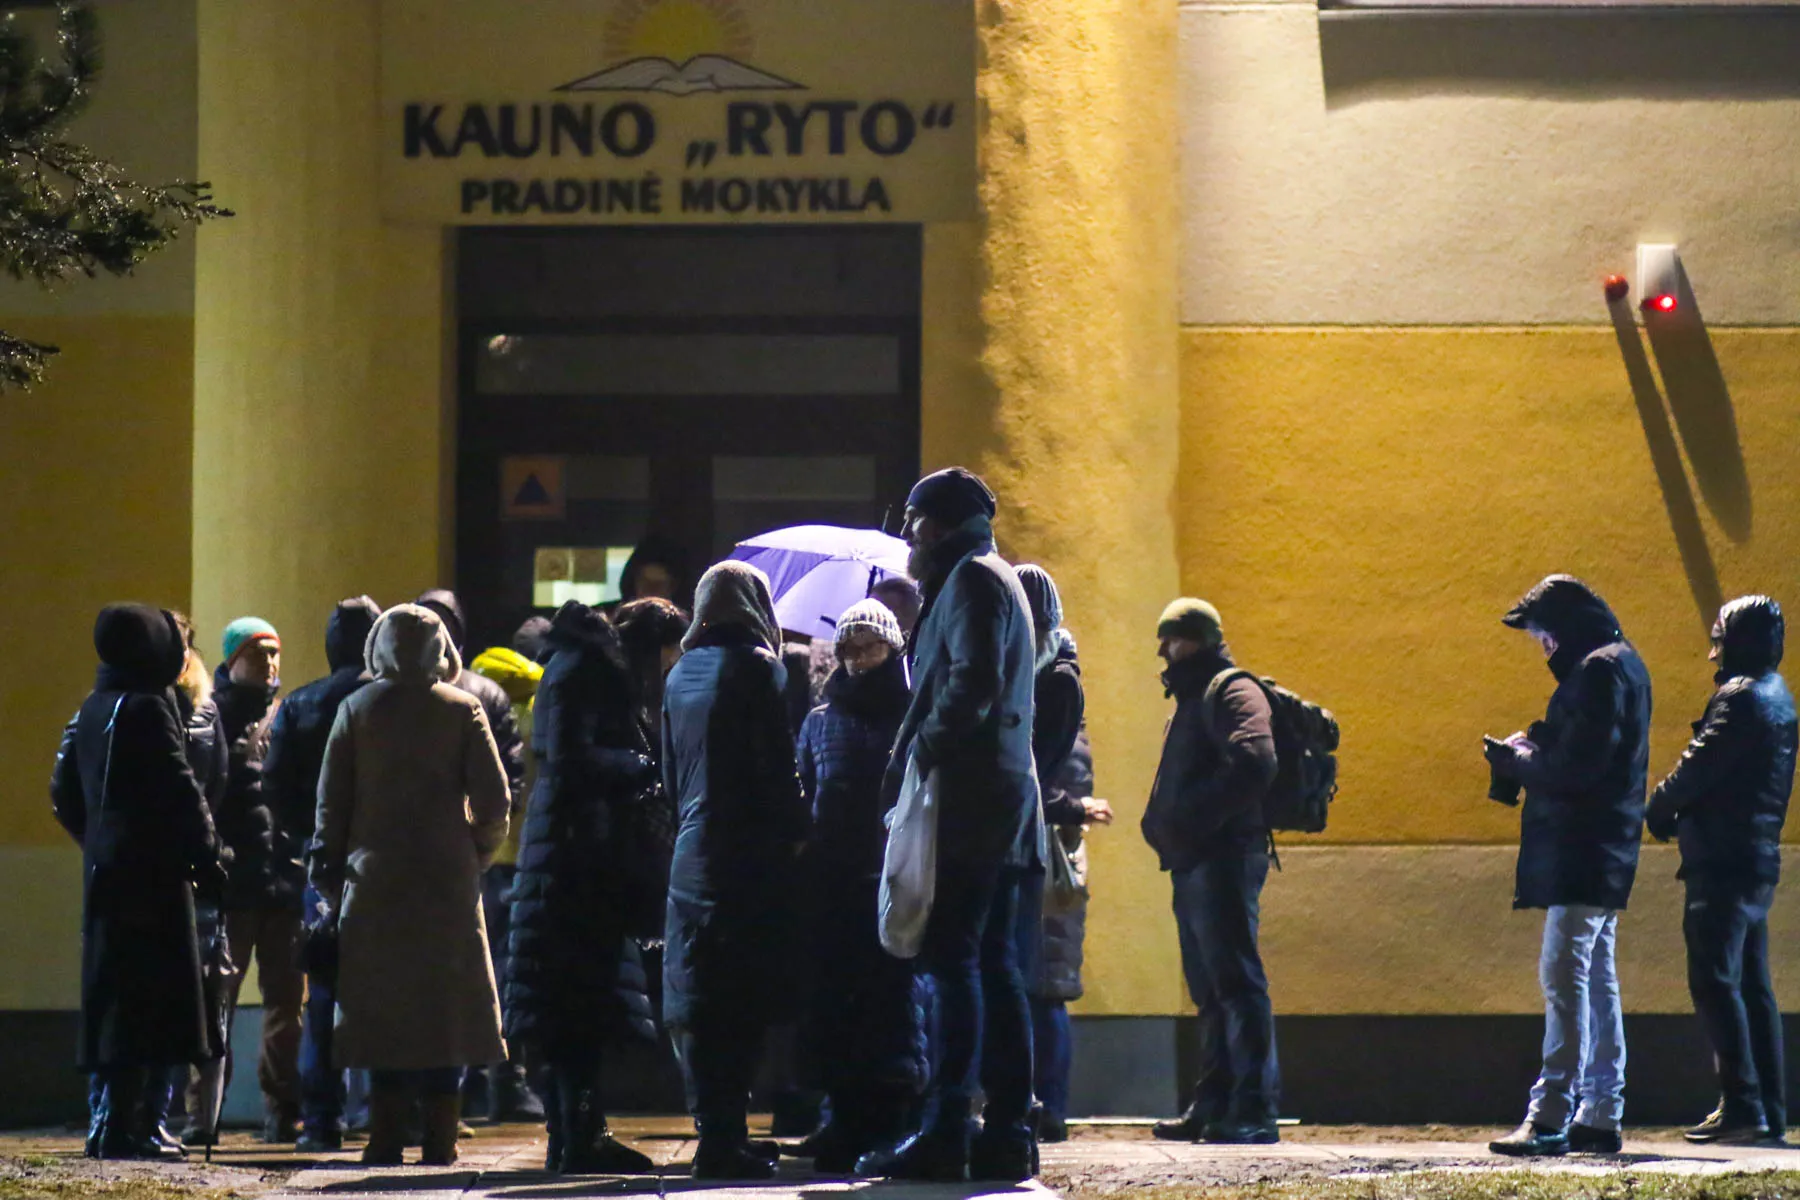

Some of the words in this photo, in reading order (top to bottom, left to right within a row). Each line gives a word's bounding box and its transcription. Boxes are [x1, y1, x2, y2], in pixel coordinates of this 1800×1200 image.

[403, 102, 656, 159] KAUNO
[460, 172, 661, 215] PRADINĖ
[681, 177, 891, 213] MOKYKLA
